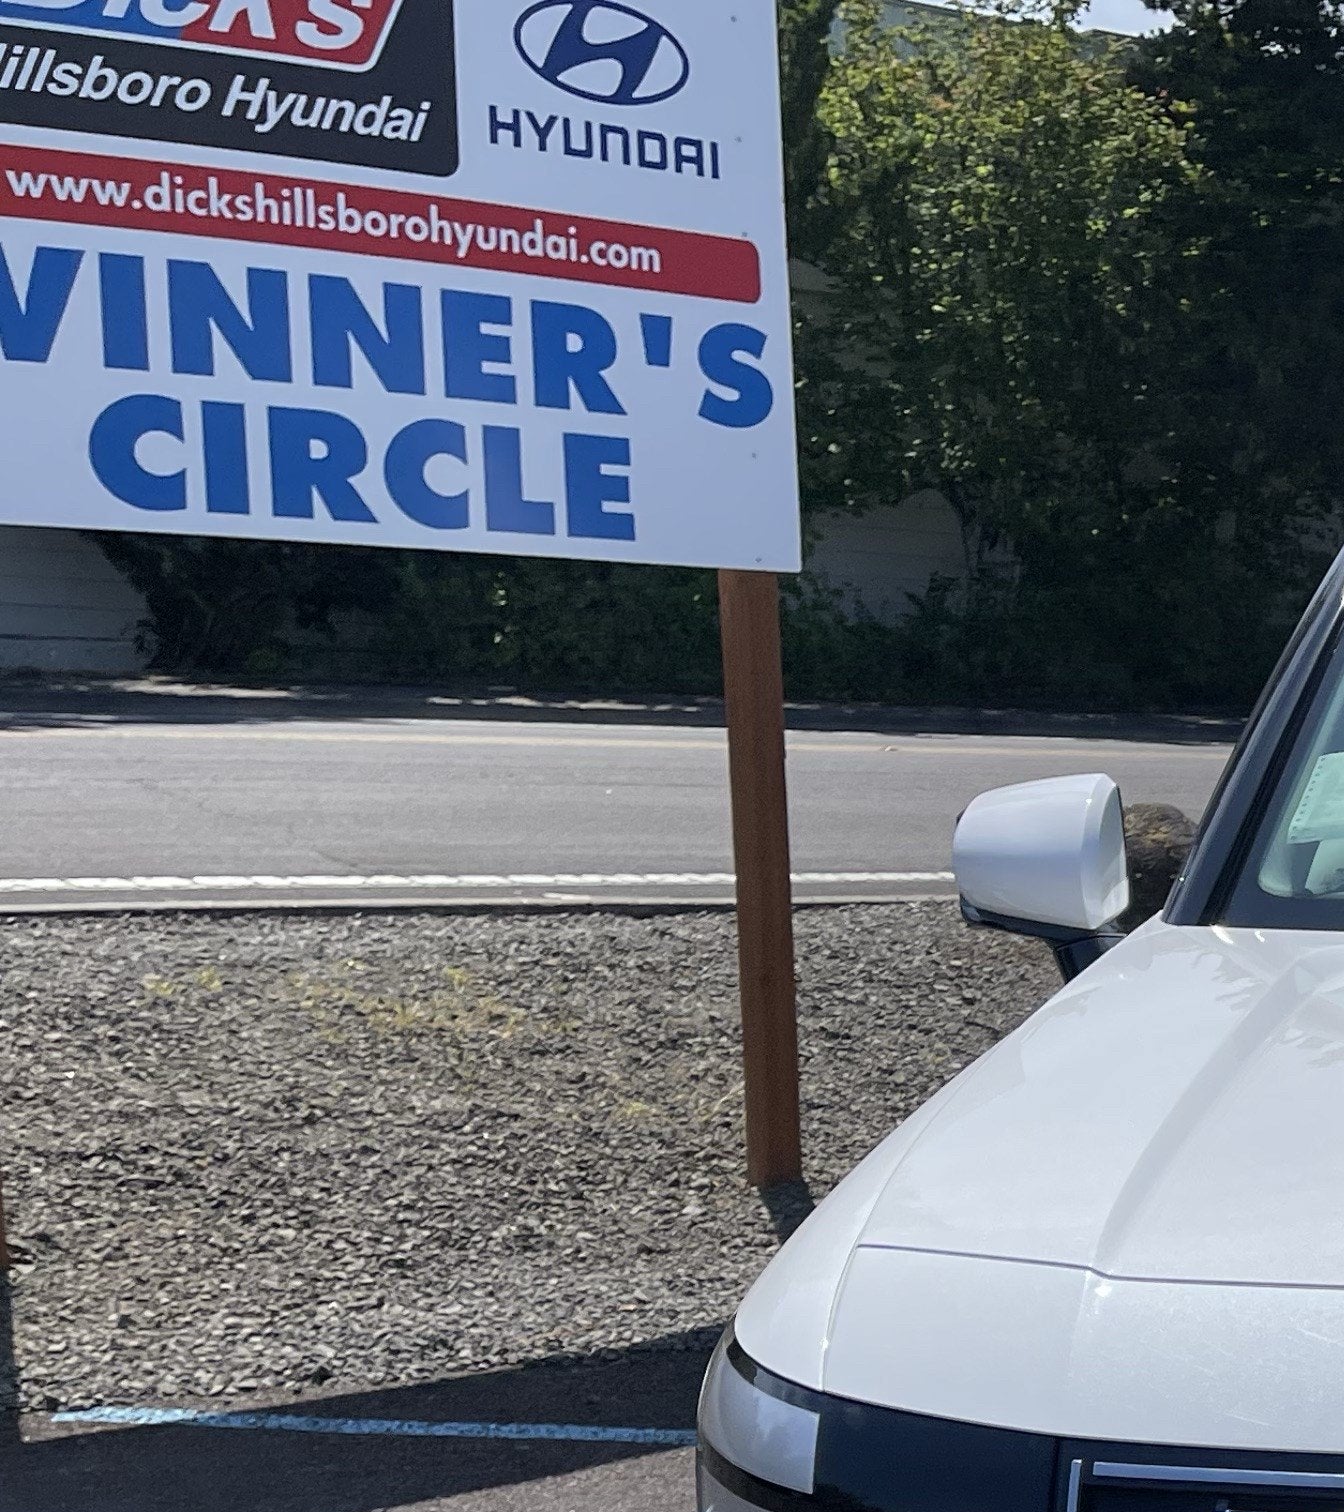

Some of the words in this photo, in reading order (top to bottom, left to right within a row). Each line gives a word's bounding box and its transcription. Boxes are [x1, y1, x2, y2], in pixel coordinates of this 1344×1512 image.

[0, 42, 212, 112] illsboro
[221, 74, 432, 142] Hyundai
[489, 104, 720, 180] HYUNDAI
[5, 165, 662, 274] www.dickshillsborohyundai.com
[88, 394, 636, 542] CIRCLE
